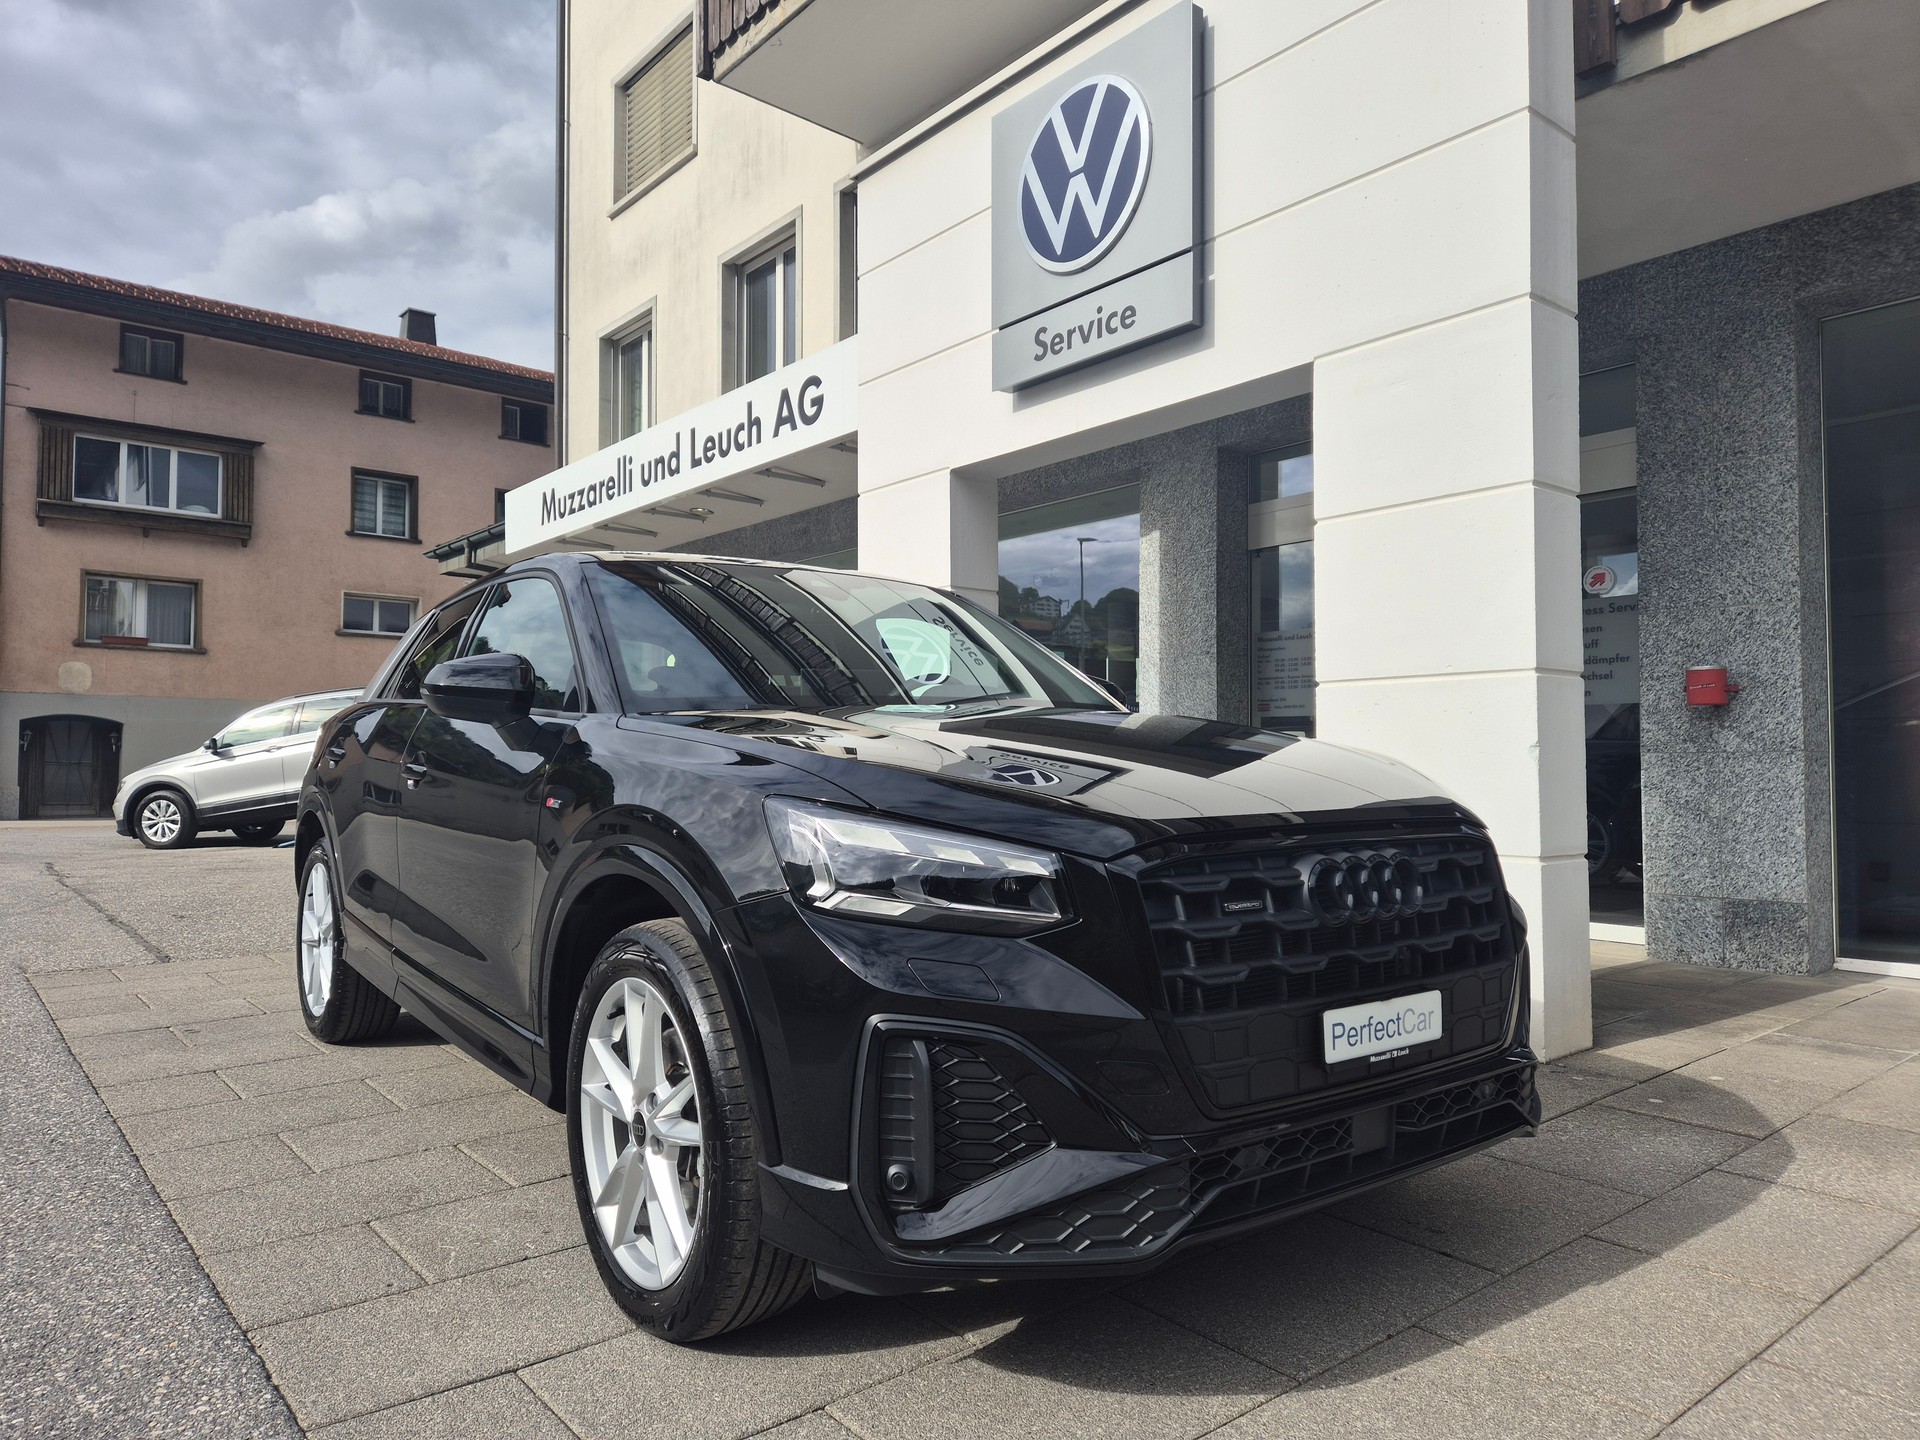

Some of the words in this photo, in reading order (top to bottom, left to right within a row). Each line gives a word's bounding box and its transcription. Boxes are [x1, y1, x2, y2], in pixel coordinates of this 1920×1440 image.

[1019, 75, 1151, 274] VW
[1033, 304, 1137, 362] Service
[541, 453, 633, 526] Muzzarelli
[640, 432, 681, 488] und
[690, 401, 762, 468] Leuch
[772, 375, 825, 438] AG
[1583, 606, 1604, 615] ess
[1583, 625, 1603, 633] sen
[1584, 639, 1599, 649] uff
[1584, 653, 1630, 665] dämpfer
[1581, 670, 1613, 681] echsel
[1331, 1007, 1435, 1051] PerfectCar
